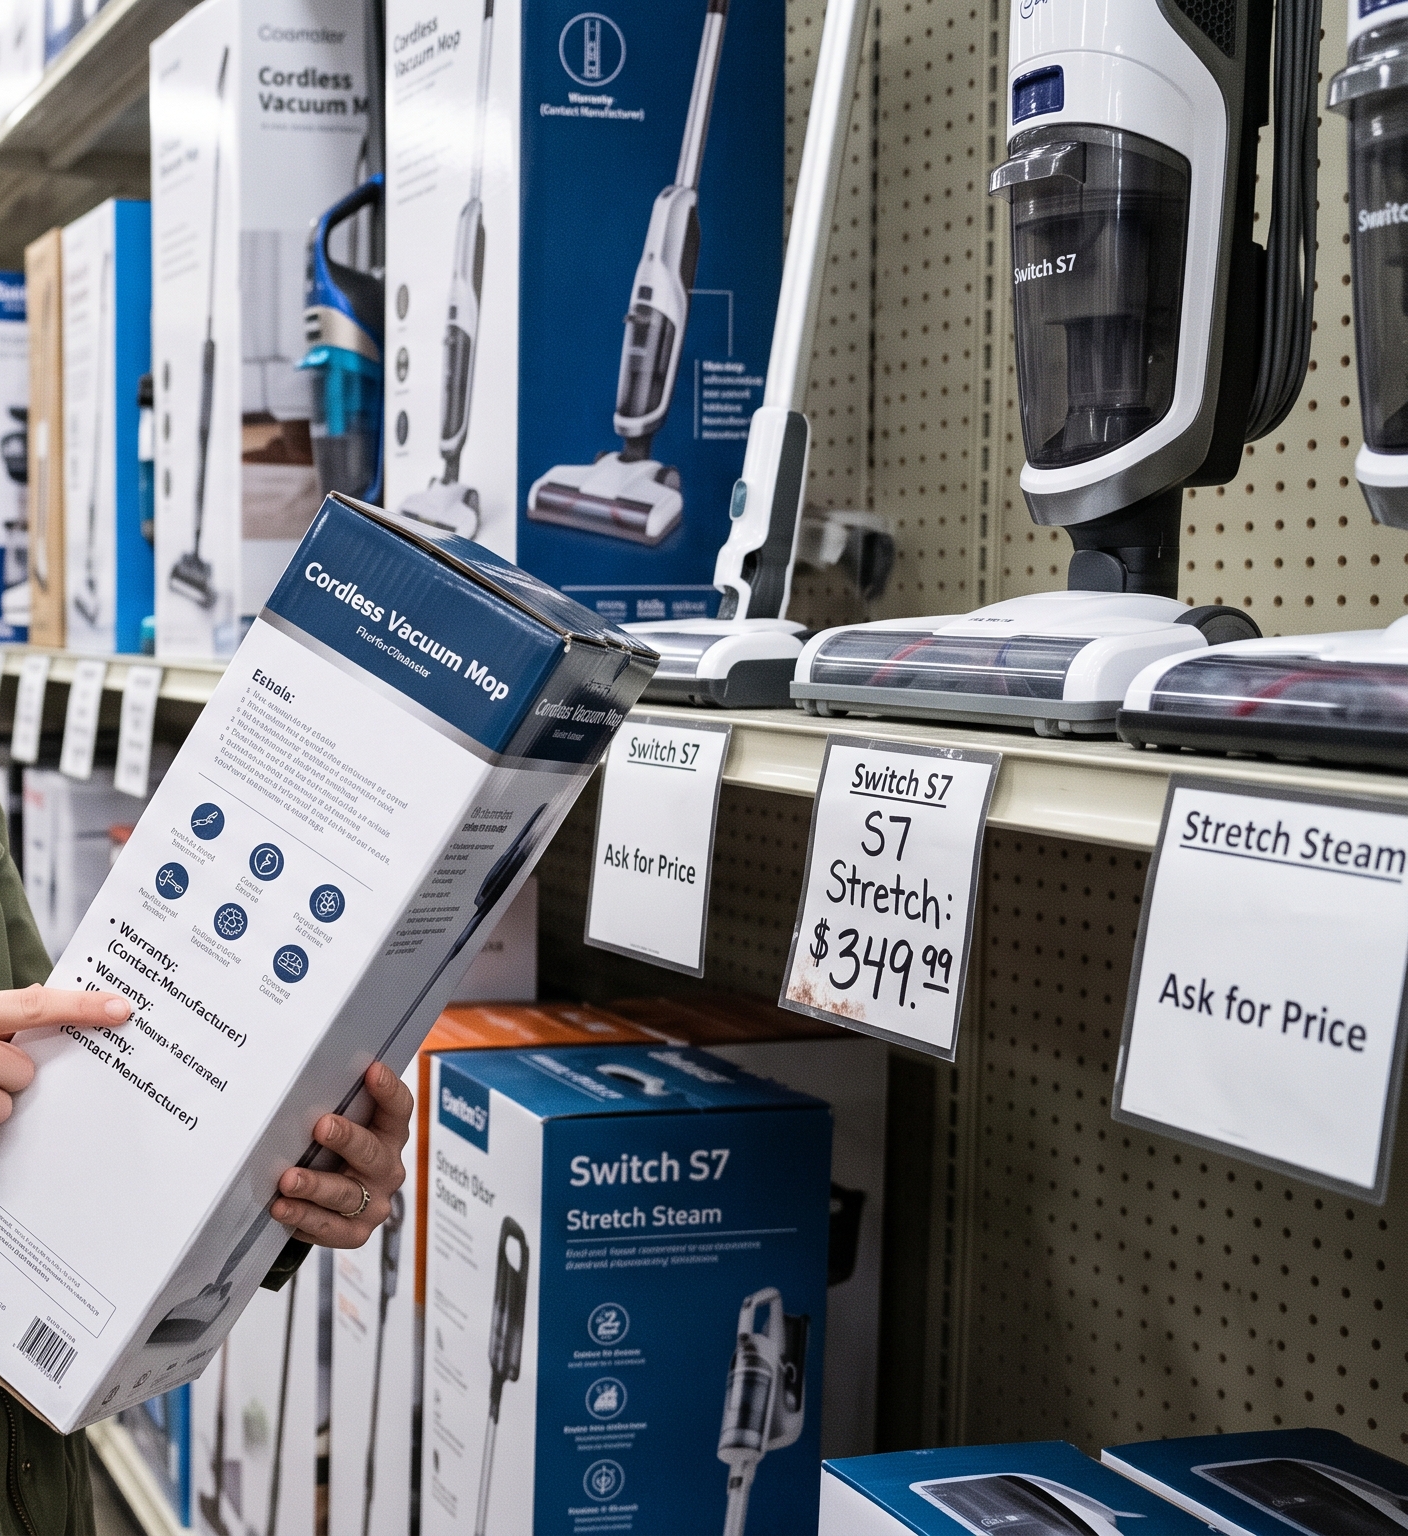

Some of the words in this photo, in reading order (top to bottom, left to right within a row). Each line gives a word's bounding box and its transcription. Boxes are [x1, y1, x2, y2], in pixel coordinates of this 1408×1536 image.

[258, 65, 353, 91] Cordless
[258, 92, 347, 115] Vacuum
[1014, 258, 1053, 285] Switch
[1056, 253, 1077, 274] S7
[304, 561, 385, 623] Cordless
[387, 609, 463, 672] Vacuum
[463, 659, 510, 702] Mop
[628, 736, 676, 763] Switch
[679, 742, 700, 766] S7
[851, 762, 919, 797] Switch
[923, 772, 953, 801] S7
[860, 810, 912, 862] S7
[1182, 810, 1291, 856] Stretch
[1300, 828, 1407, 874] Steam
[604, 843, 630, 870] Ask
[633, 847, 654, 875] for
[658, 854, 696, 885] Price
[825, 859, 953, 930] Stretch:
[119, 921, 179, 973] Warranty:
[95, 960, 154, 1012] Warranty:
[1158, 973, 1215, 1016] Ask
[1225, 984, 1271, 1028] for
[1280, 1000, 1367, 1053] Price
[569, 1150, 680, 1187] Switch
[689, 1148, 731, 1181] S7
[566, 1206, 646, 1231] Stretch
[652, 1205, 723, 1227] Steam
